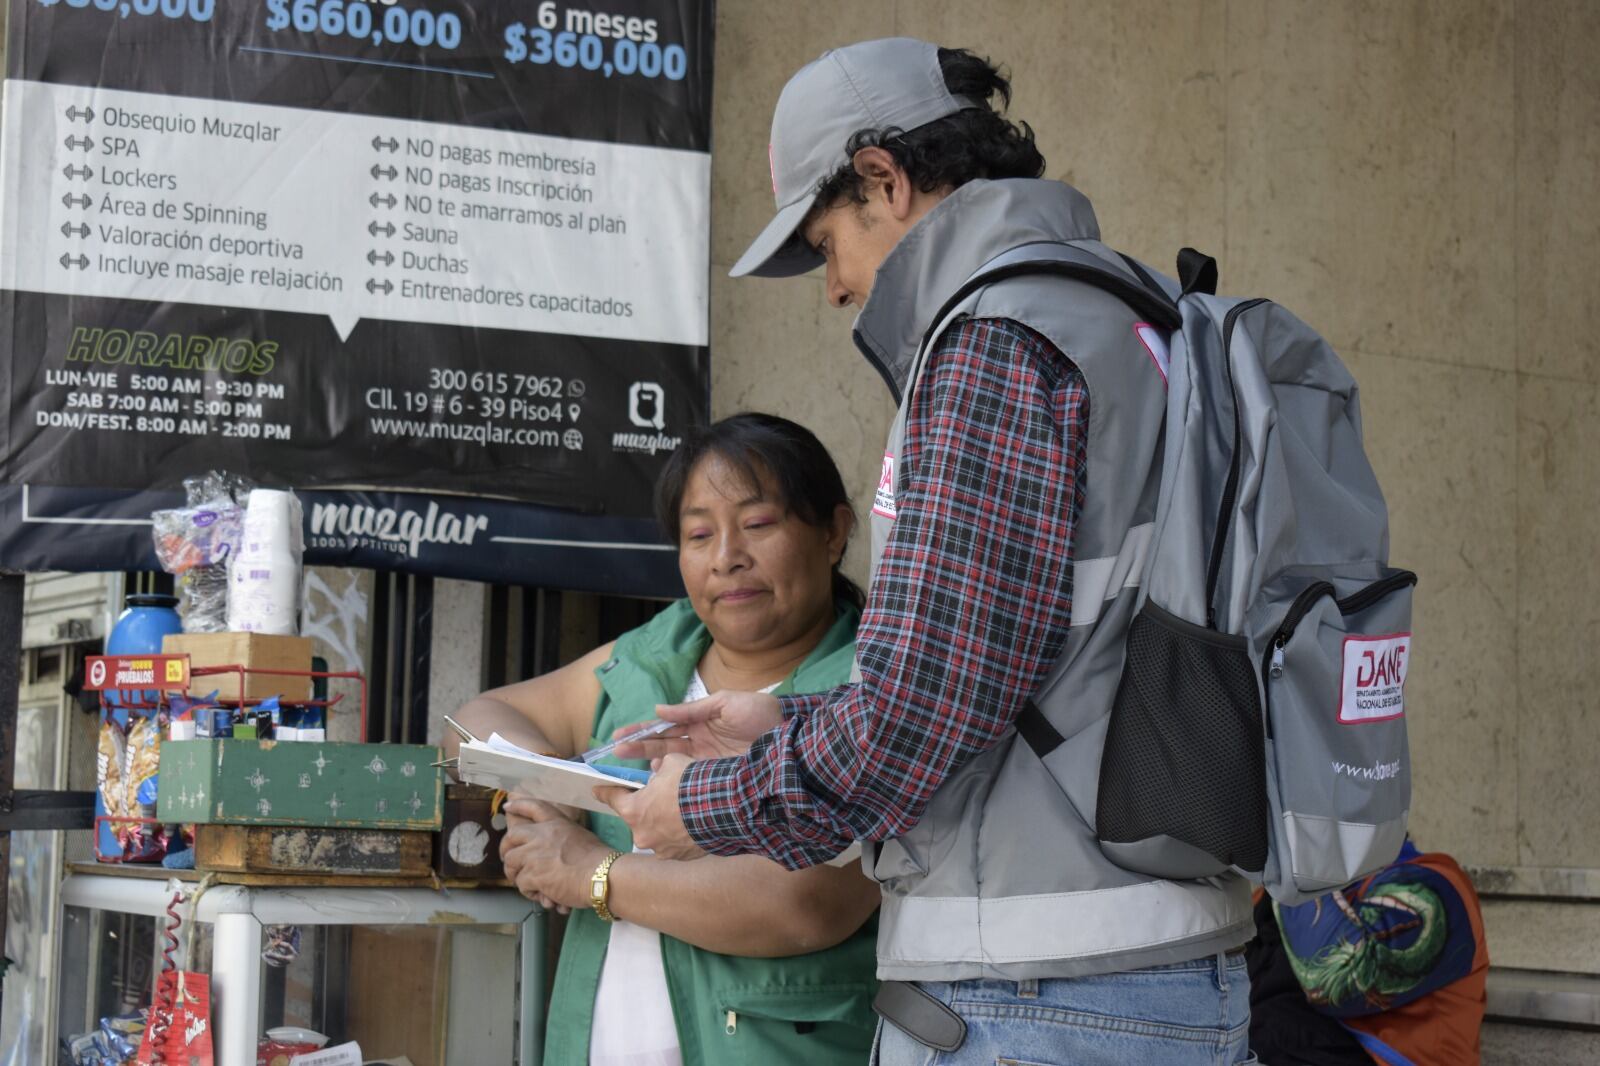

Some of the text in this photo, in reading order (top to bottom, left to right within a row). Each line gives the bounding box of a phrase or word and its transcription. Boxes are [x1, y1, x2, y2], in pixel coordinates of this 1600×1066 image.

[266, 0, 461, 49] $660,000
[538, 2, 658, 43] 6 meses
[504, 23, 687, 80] $360,000
[103, 107, 281, 142] Obsequio Muzqlar
[102, 137, 139, 157] SPA
[406, 138, 596, 176] NO pagas membresía
[101, 166, 177, 190] Lockers
[405, 167, 593, 203] NO pagas Inscripción
[100, 192, 267, 230] Área de Spinning
[404, 195, 626, 234] NO te amarramos al plan
[99, 225, 304, 259] Valoración deportiva
[403, 223, 458, 245] Sauna
[98, 254, 343, 292] Incluye masaje relajación
[402, 252, 469, 274] Duchas
[401, 280, 633, 317] Entrenadores capacitados
[67, 327, 279, 375] HORARIOS
[46, 370, 118, 389] LUN-VIE
[130, 376, 168, 392] 5:00
[172, 378, 201, 394] AM
[216, 381, 253, 397] 9:30
[257, 382, 284, 399] PM
[429, 368, 563, 398] 300 615 7962
[67, 393, 103, 408] SAB
[107, 395, 146, 411] 7:00
[150, 397, 179, 413] AM
[194, 400, 231, 416] 5:00
[235, 402, 262, 418] PM
[404, 391, 428, 412] 19
[433, 395, 446, 412] #
[449, 397, 463, 415] 6
[480, 399, 505, 418] 39
[37, 411, 132, 432] DOM/FEST.
[136, 416, 175, 433] 8:00
[178, 419, 207, 435] AM
[222, 422, 259, 438] 2:00
[264, 424, 291, 440] PM
[371, 416, 559, 447] www.muzqlar.com
[612, 431, 682, 456] muzqlar
[310, 500, 489, 559] muzqlar
[311, 537, 346, 548] 100%
